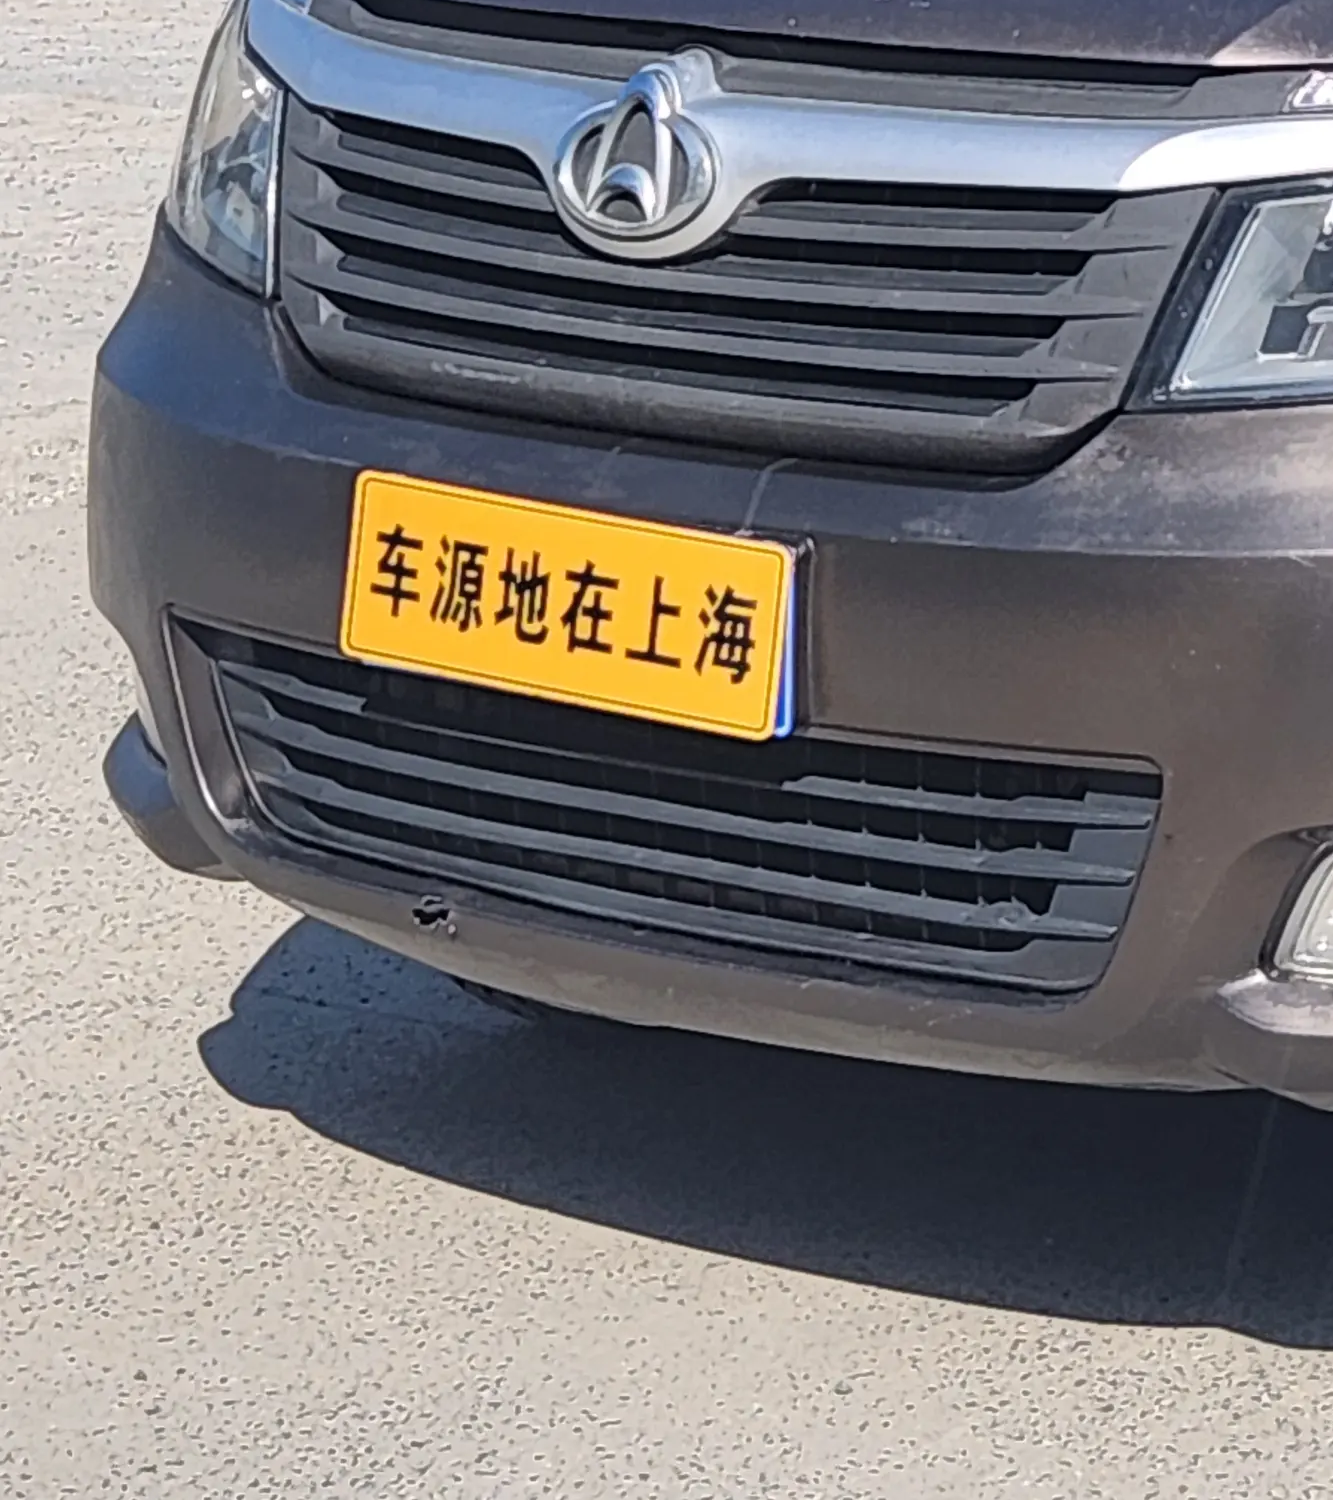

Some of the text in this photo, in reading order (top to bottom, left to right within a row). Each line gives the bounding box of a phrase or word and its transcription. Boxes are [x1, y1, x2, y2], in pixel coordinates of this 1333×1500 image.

[370, 523, 757, 684] 车源地在上海
